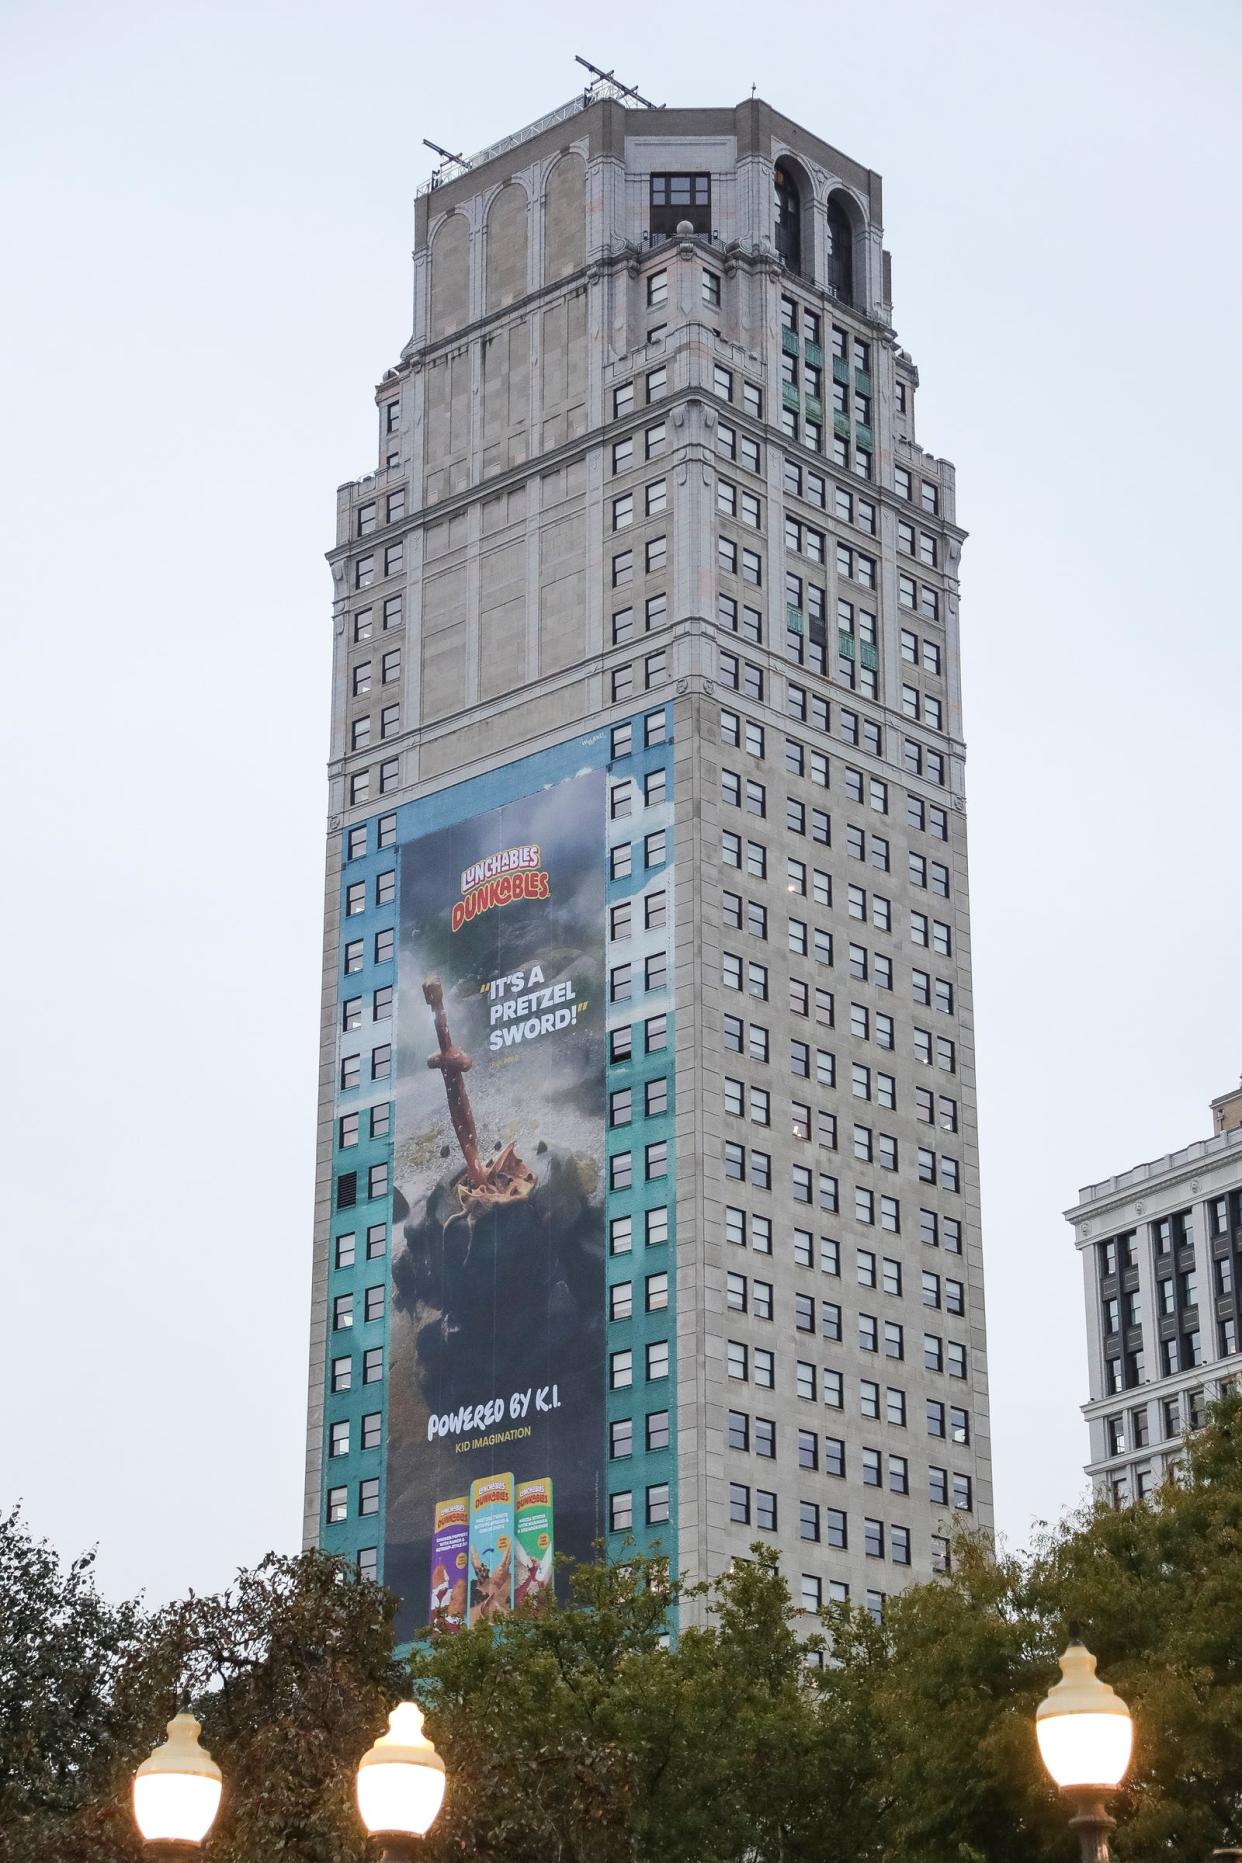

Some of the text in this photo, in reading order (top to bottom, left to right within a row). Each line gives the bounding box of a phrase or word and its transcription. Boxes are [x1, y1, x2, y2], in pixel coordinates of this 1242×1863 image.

[462, 844, 540, 895] LUNCHABLES
[452, 871, 549, 933] DUNKABLES
[528, 965, 545, 987] A
[490, 981, 576, 1026] PRETZEL
[427, 1384, 562, 1442] POWERED BY K.I.
[455, 1425, 532, 1454] KID IMAGINATION
